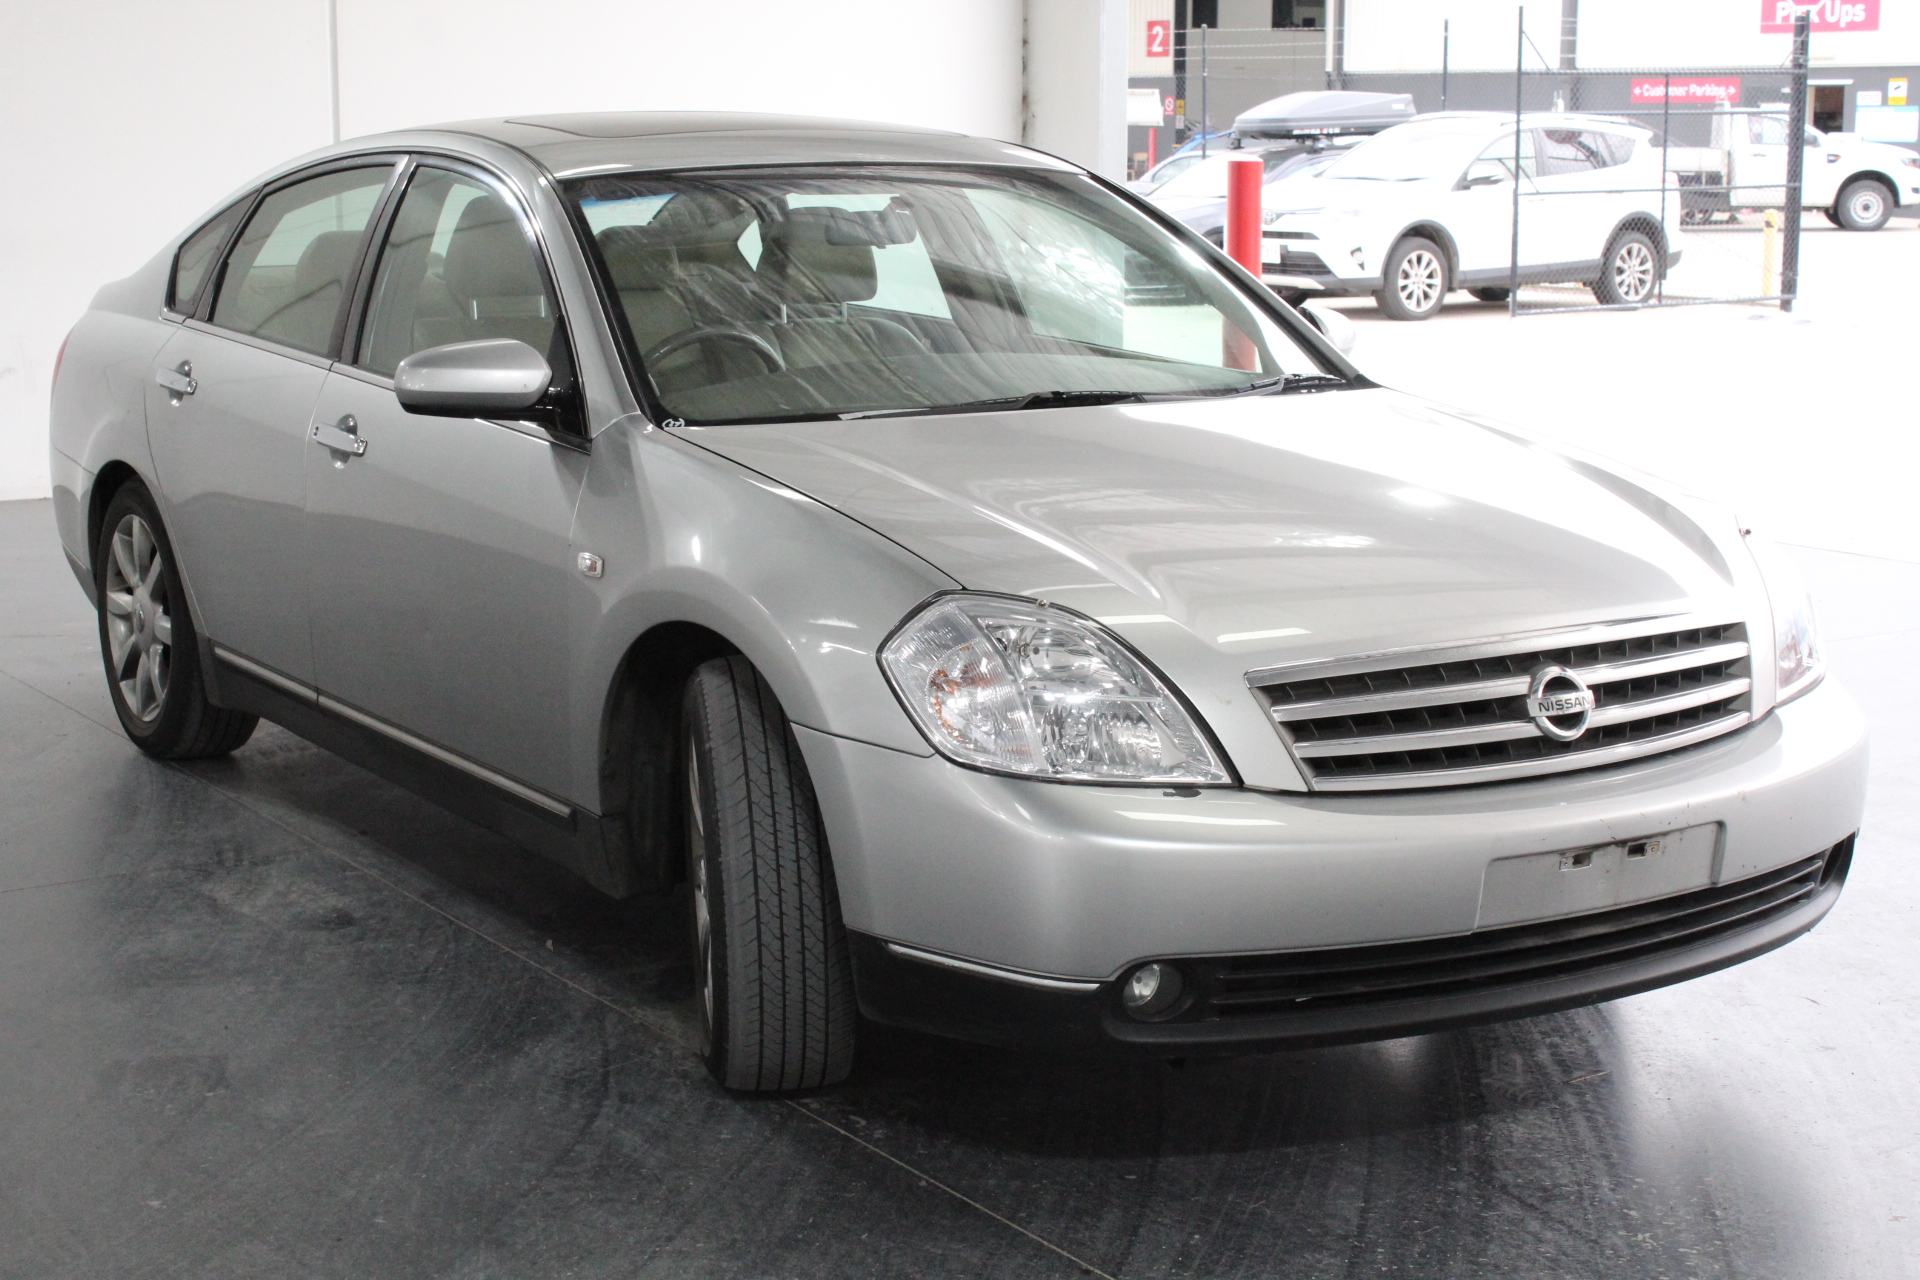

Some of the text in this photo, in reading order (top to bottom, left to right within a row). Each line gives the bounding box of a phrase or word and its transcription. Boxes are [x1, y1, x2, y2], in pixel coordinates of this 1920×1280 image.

[1825, 0, 1866, 27] Ups
[1151, 25, 1164, 52] 2
[1689, 83, 1726, 98] Parking
[1538, 695, 1591, 712] NISSAN
